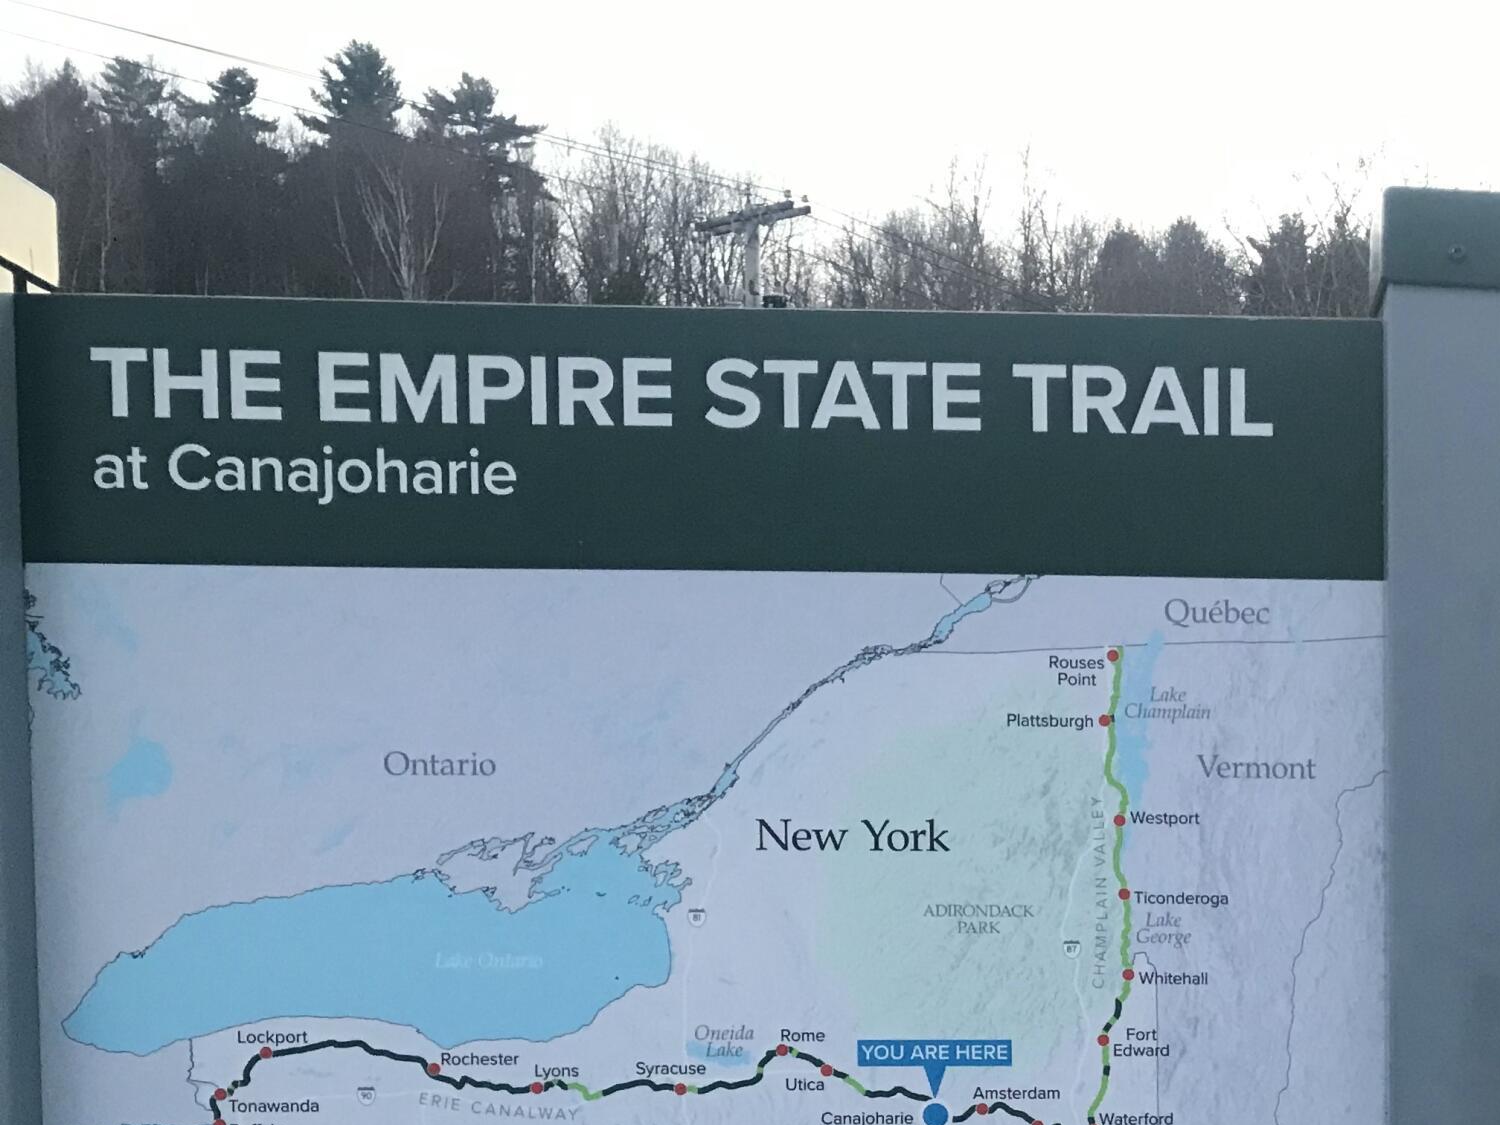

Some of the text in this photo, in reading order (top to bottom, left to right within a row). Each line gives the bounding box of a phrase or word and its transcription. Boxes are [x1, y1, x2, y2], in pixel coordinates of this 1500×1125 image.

[90, 347, 1273, 437] THE EMPIRE STATE TRAIL
[93, 443, 517, 505] at Canajoharie
[1164, 598, 1271, 628] Québec
[1049, 656, 1104, 670] Rouses
[1057, 672, 1096, 686] Point
[1006, 714, 1094, 730] Plattsburgh
[383, 750, 497, 778] Ontario
[1197, 754, 1316, 780] Vermont
[1130, 811, 1200, 827] Westport
[755, 818, 951, 852] New York
[1134, 891, 1229, 908] Ticonderoga
[923, 904, 1034, 918] ADIRONDACK
[957, 921, 1000, 934] PARK
[1139, 972, 1208, 985] Whitehall
[237, 1030, 308, 1044] Lockport
[781, 1029, 825, 1043] Rome
[1126, 1028, 1157, 1042] Fort
[861, 1045, 1008, 1060] YOU ARE HERE
[1113, 1044, 1170, 1058] Edward
[441, 1052, 519, 1067] Rochester
[534, 1064, 579, 1079] Lyons
[635, 1062, 706, 1077] Syracuse
[785, 1078, 825, 1093] Utica
[973, 1087, 1060, 1100] Amsterdam
[229, 1100, 319, 1113] Tonawanda
